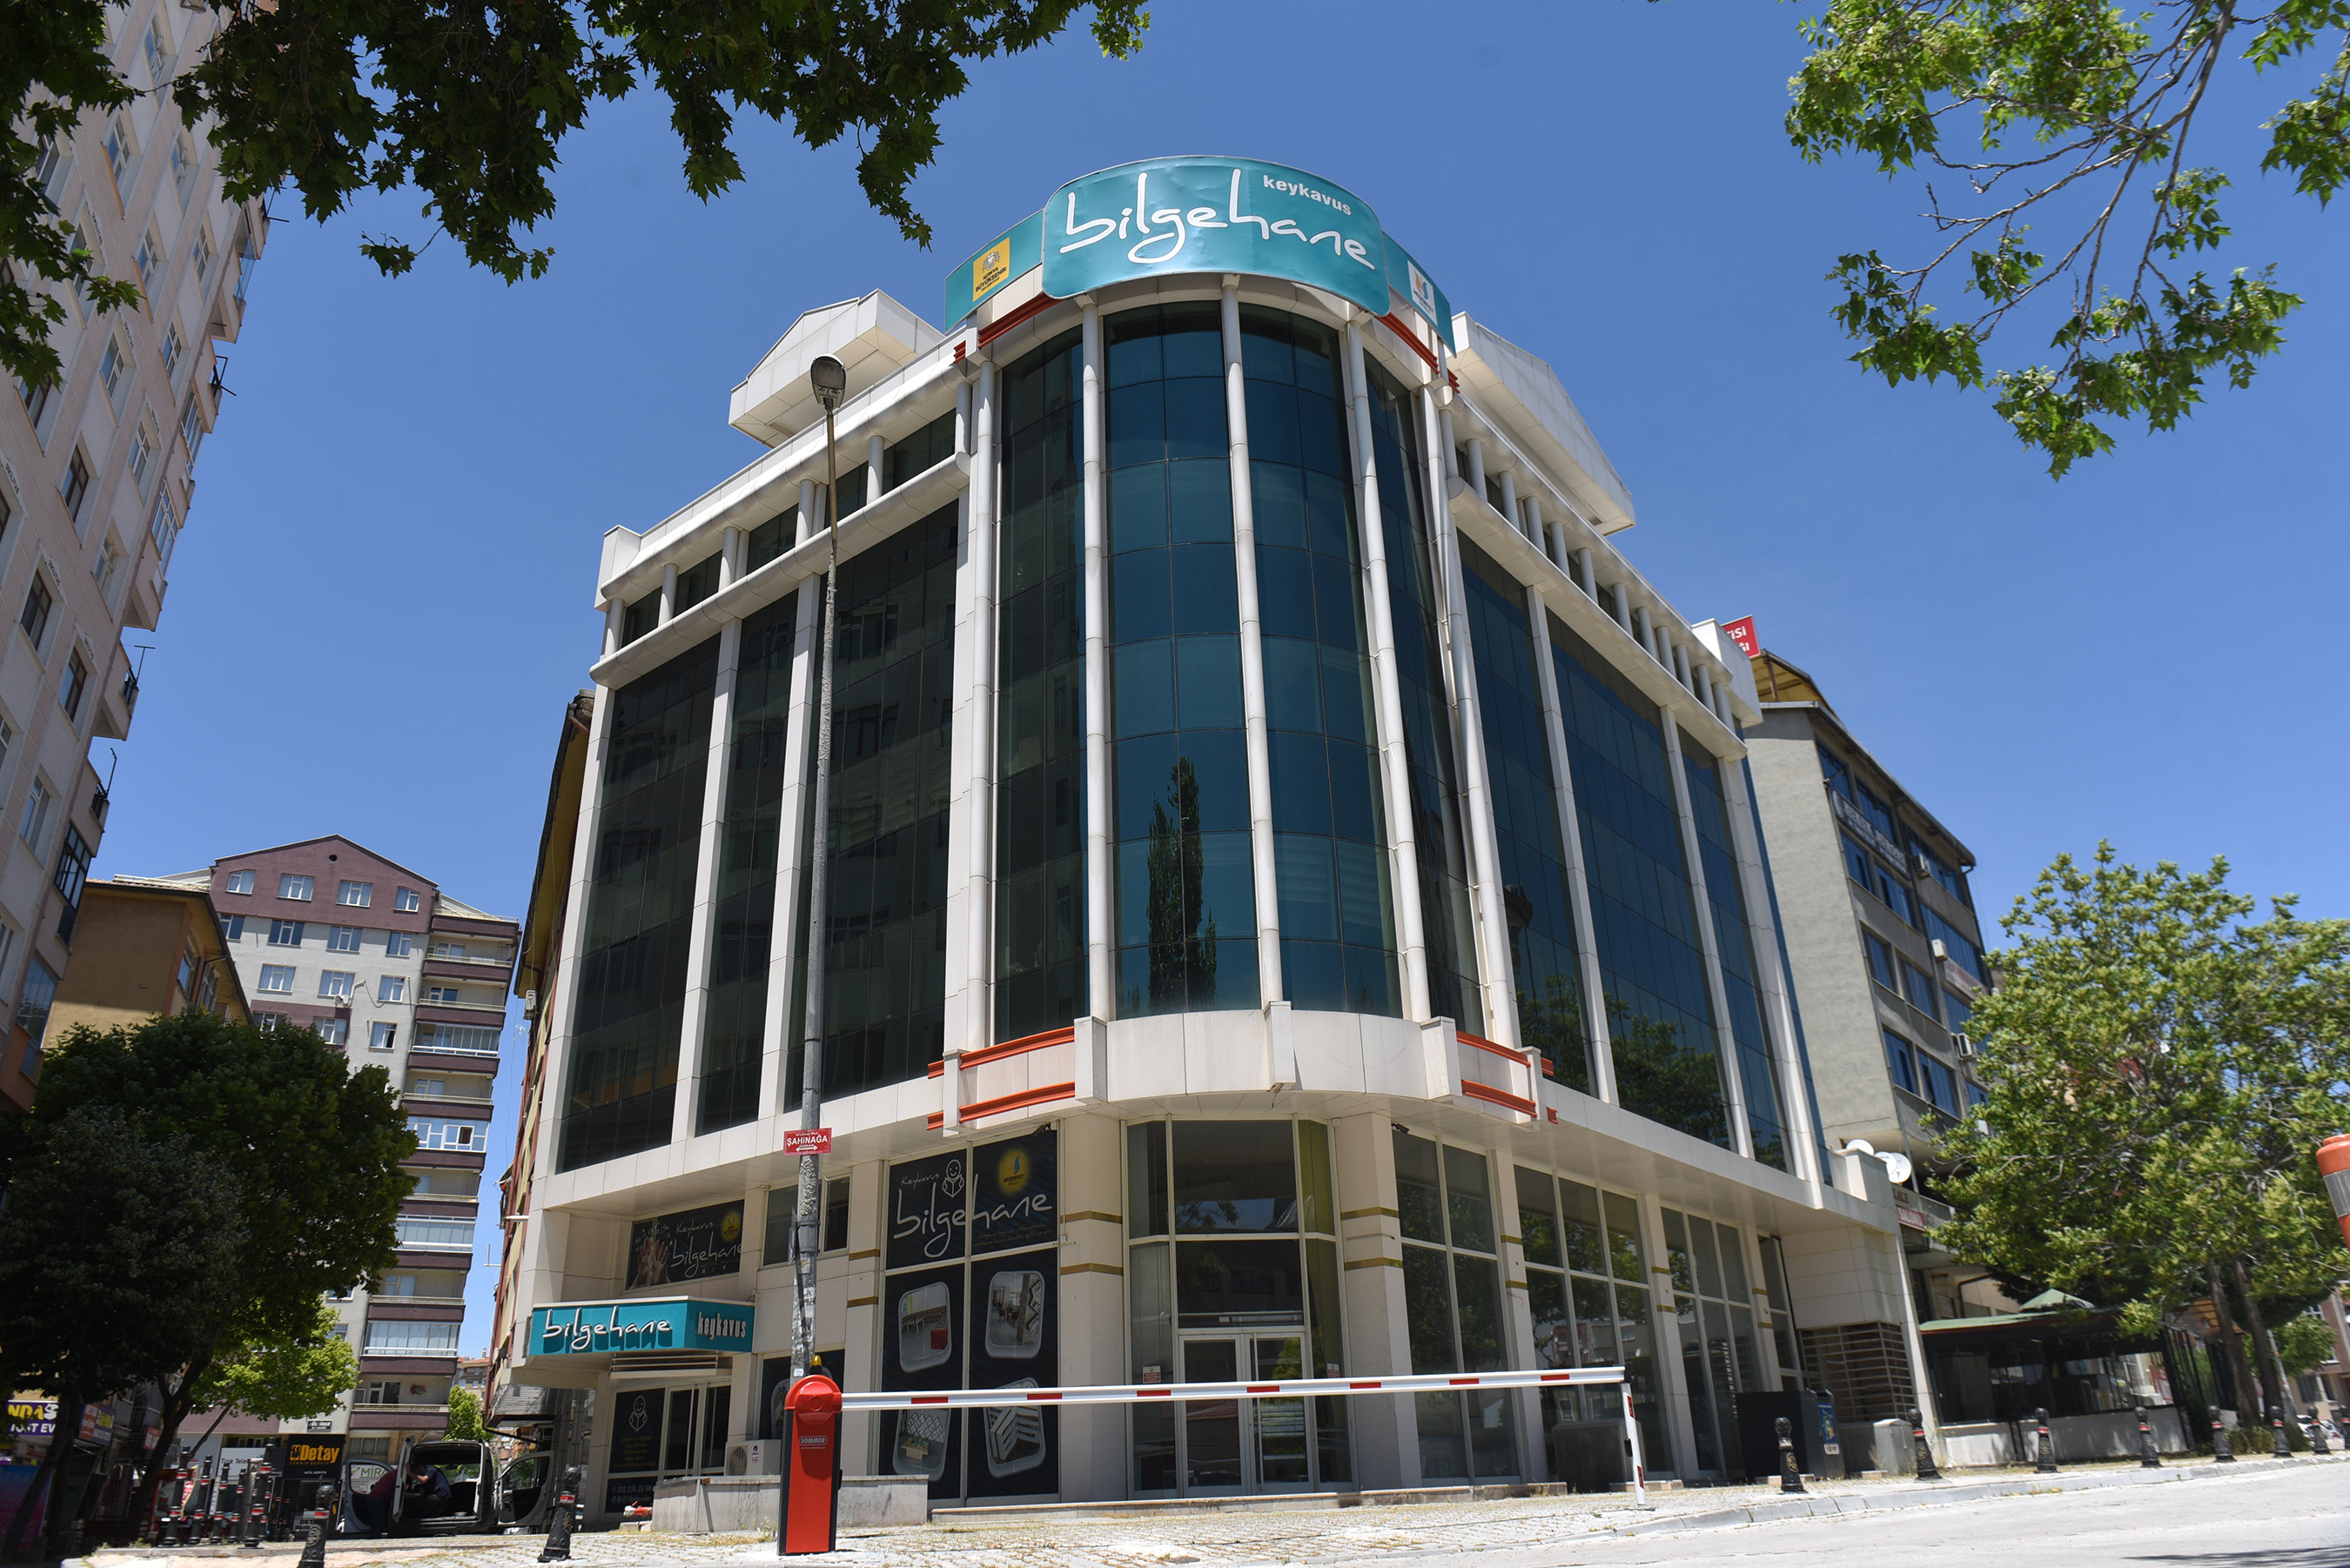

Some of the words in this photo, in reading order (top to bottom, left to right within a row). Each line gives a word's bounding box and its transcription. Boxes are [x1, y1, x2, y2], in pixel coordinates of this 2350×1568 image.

[1262, 174, 1353, 217] keykavus
[1059, 168, 1376, 271] bilgehane
[786, 1134, 828, 1147] ŞAHİNAĞA
[901, 1171, 940, 1189] Keykavus
[893, 1173, 1053, 1258] bilgehane
[670, 1231, 742, 1278] bilgehane
[542, 1305, 673, 1350] bilgehane
[697, 1310, 746, 1341] keykavus
[299, 1444, 340, 1464] Detay
